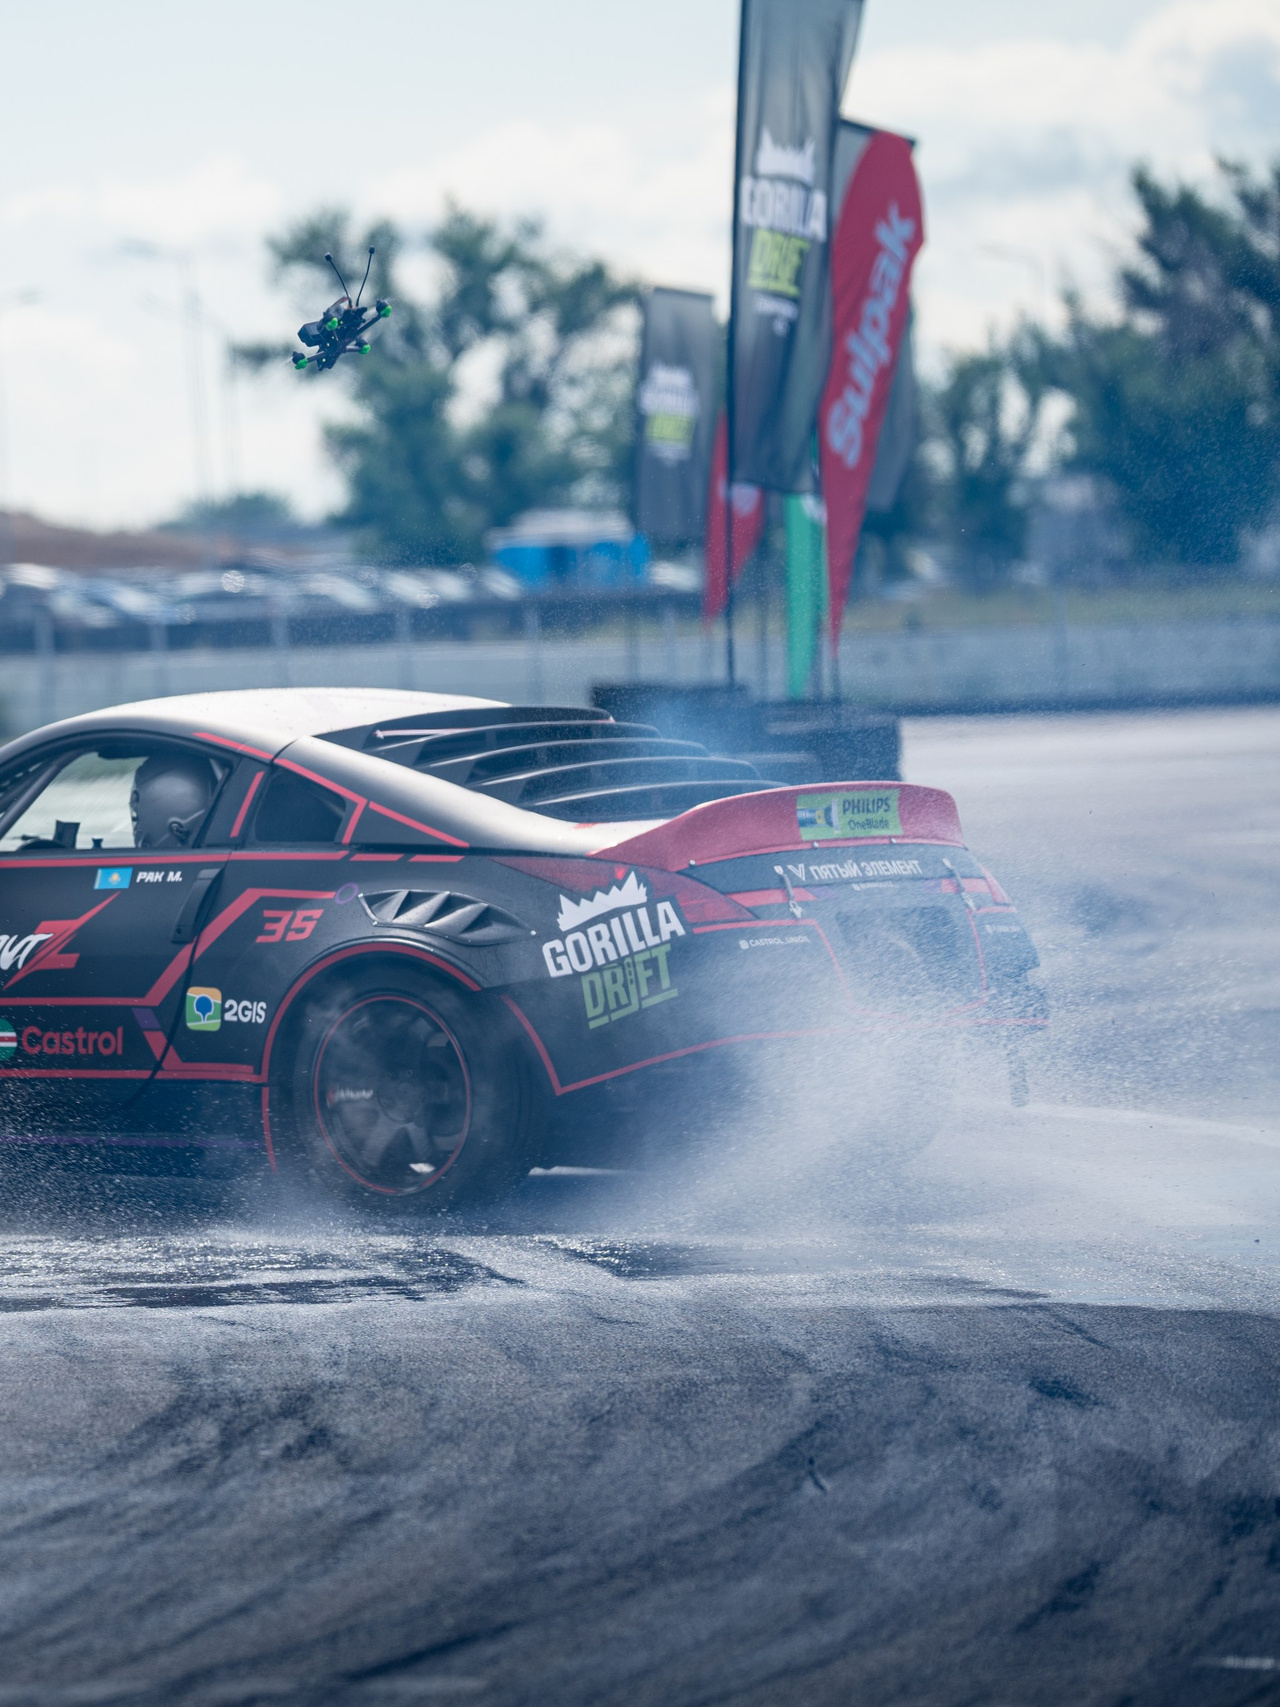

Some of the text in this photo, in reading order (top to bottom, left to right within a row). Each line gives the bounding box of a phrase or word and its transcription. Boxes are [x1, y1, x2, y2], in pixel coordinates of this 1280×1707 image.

[826, 201, 916, 469] Sulpak
[842, 796, 891, 815] PHILIPS
[847, 818, 890, 831] OneBlade
[136, 871, 183, 883] PAK M.
[810, 859, 863, 881] ПЯТЫЙ
[860, 859, 922, 877] ЭЛЕМЕНТ
[255, 908, 324, 943] 35
[542, 901, 686, 978] GORILLA
[580, 943, 676, 1027] DRIFT
[224, 1000, 267, 1024] 2GIS
[21, 1025, 124, 1056] Castrol
